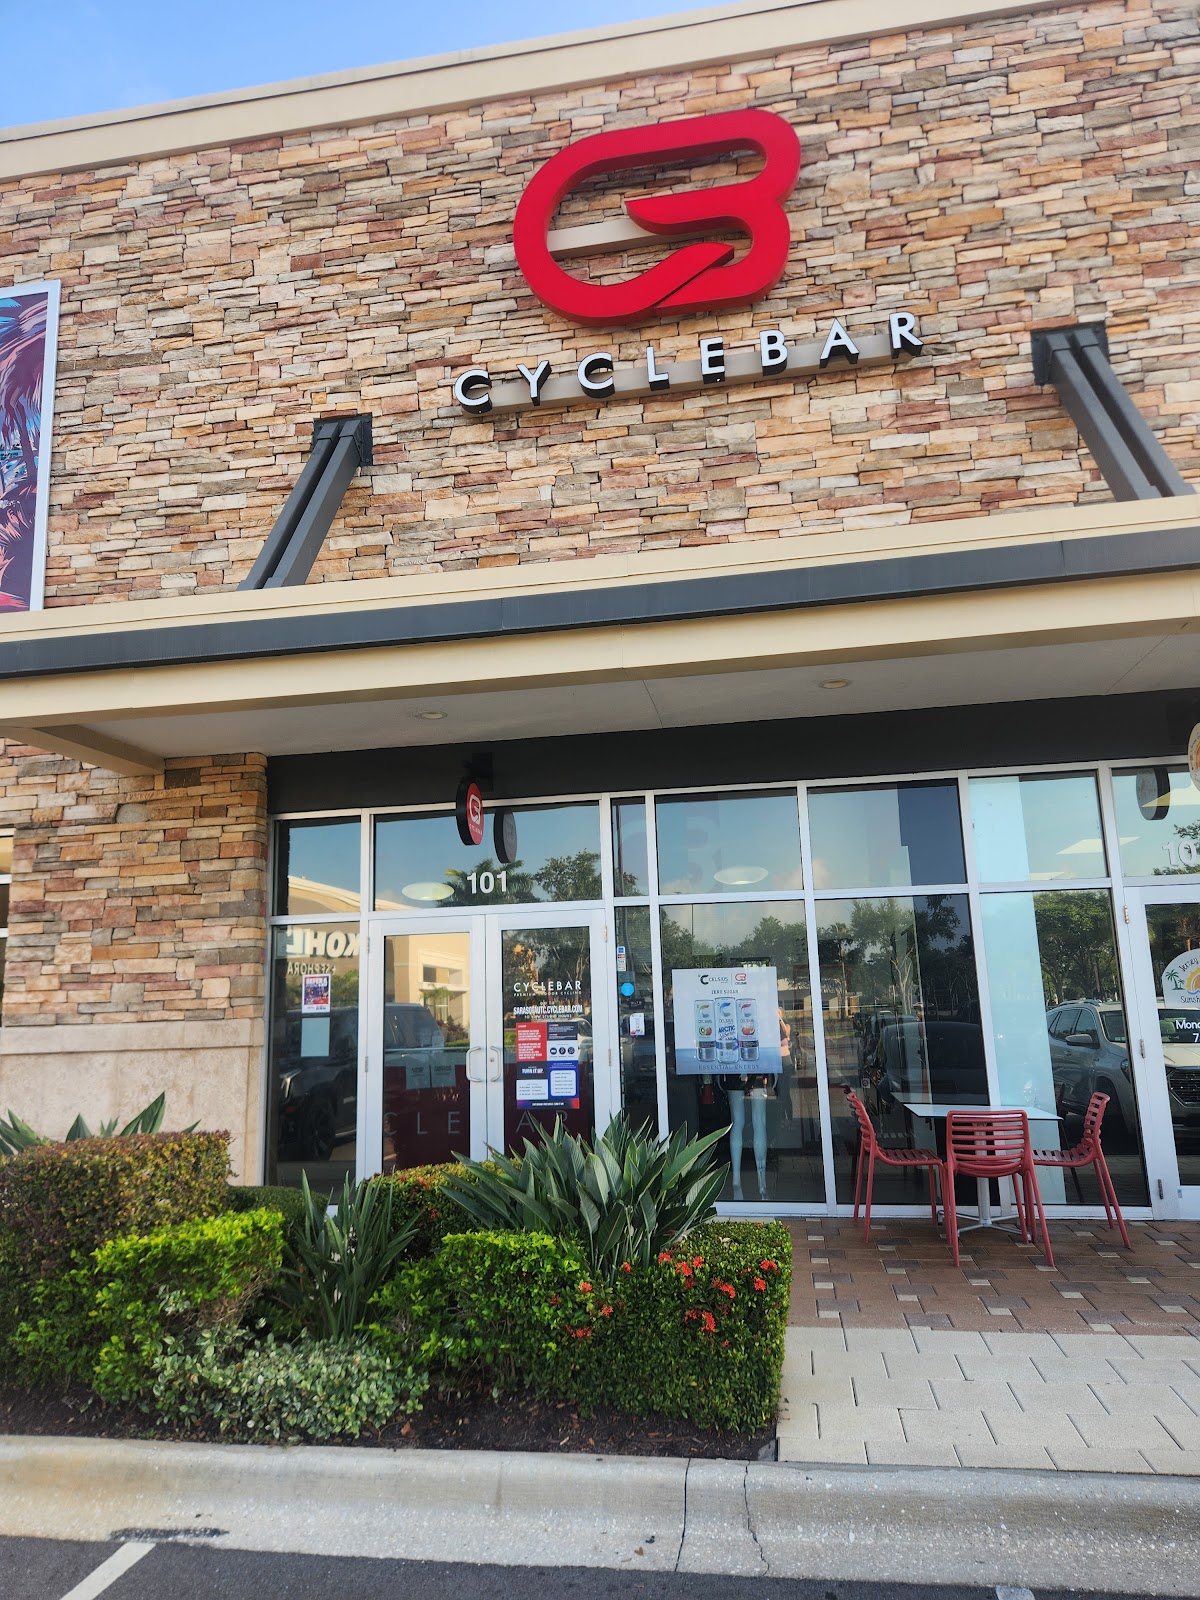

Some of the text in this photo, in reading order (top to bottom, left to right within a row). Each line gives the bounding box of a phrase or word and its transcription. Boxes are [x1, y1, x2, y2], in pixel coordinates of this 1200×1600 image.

[453, 311, 924, 413] CYCLEBAR
[467, 871, 508, 894] 101
[513, 980, 582, 993] CYCLEBAR
